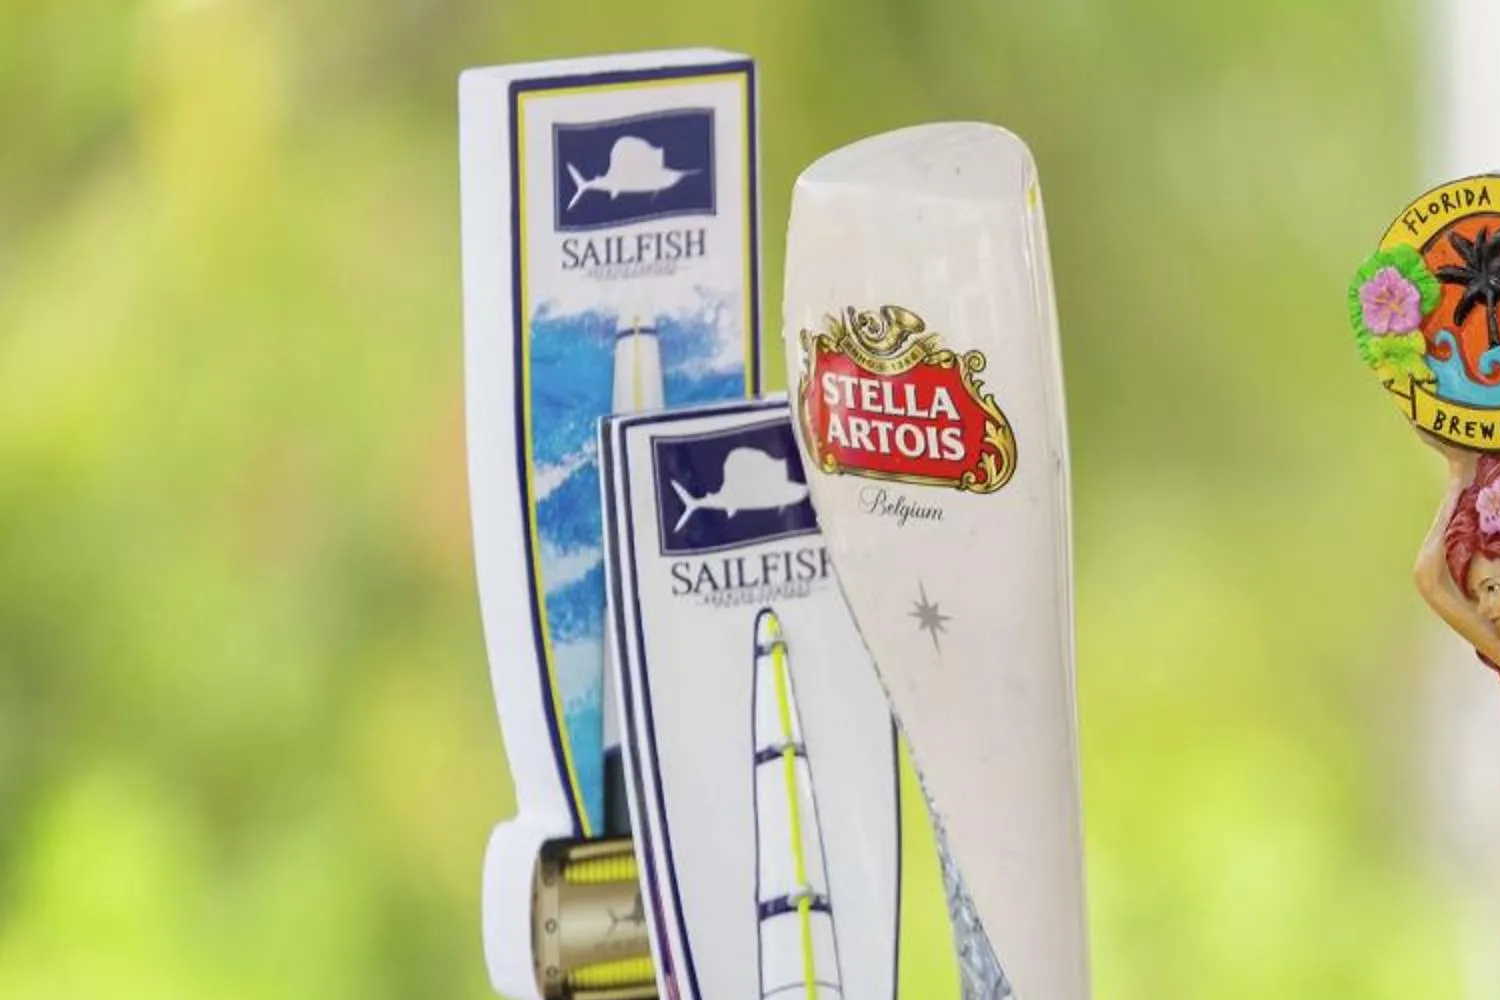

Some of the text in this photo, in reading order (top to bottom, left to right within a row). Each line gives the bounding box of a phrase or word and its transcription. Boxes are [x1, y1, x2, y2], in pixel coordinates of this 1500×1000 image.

[1401, 186, 1492, 235] FLORIDA
[561, 229, 705, 269] SAILFISH
[822, 372, 960, 420] STELLA
[828, 412, 965, 461] ARTOIS
[859, 483, 945, 527] Belgium
